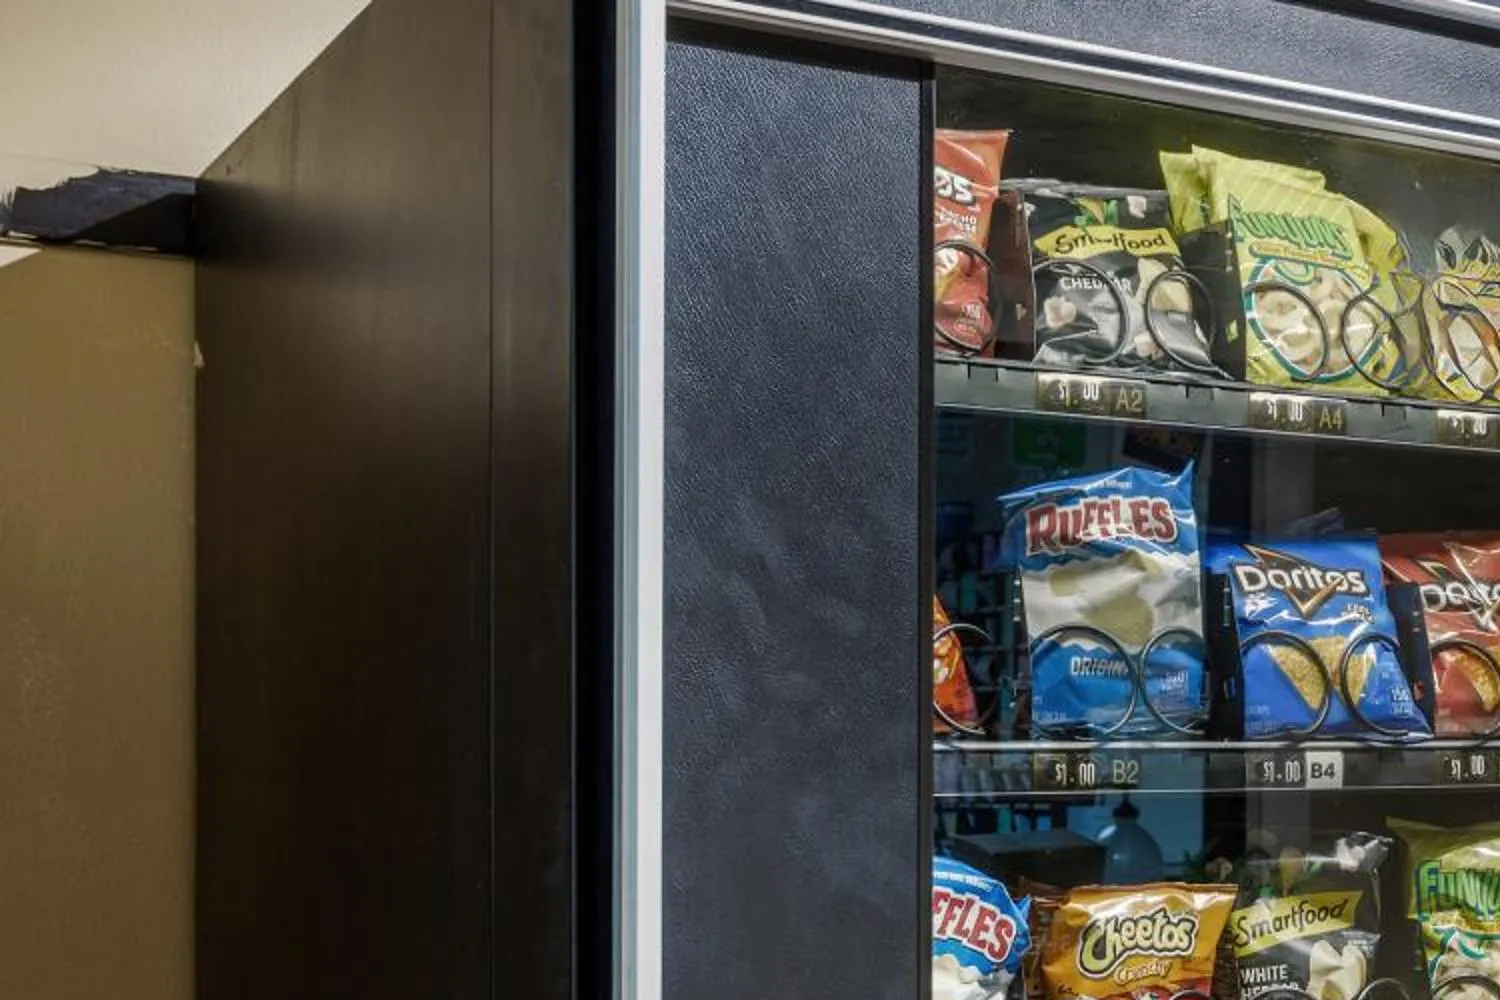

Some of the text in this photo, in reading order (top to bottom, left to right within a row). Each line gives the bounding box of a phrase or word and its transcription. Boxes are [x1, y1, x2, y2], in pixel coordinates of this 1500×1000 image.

[1115, 388, 1143, 411] A2
[1319, 408, 1343, 429] A4
[1026, 496, 1177, 556] RUFFLES
[1235, 565, 1367, 595] Doritos
[1112, 759, 1139, 784] B2
[1311, 760, 1335, 780] B4
[1233, 899, 1348, 948] Smartfood
[1077, 907, 1198, 979] Cheetos
[1240, 964, 1288, 984] WHITE
